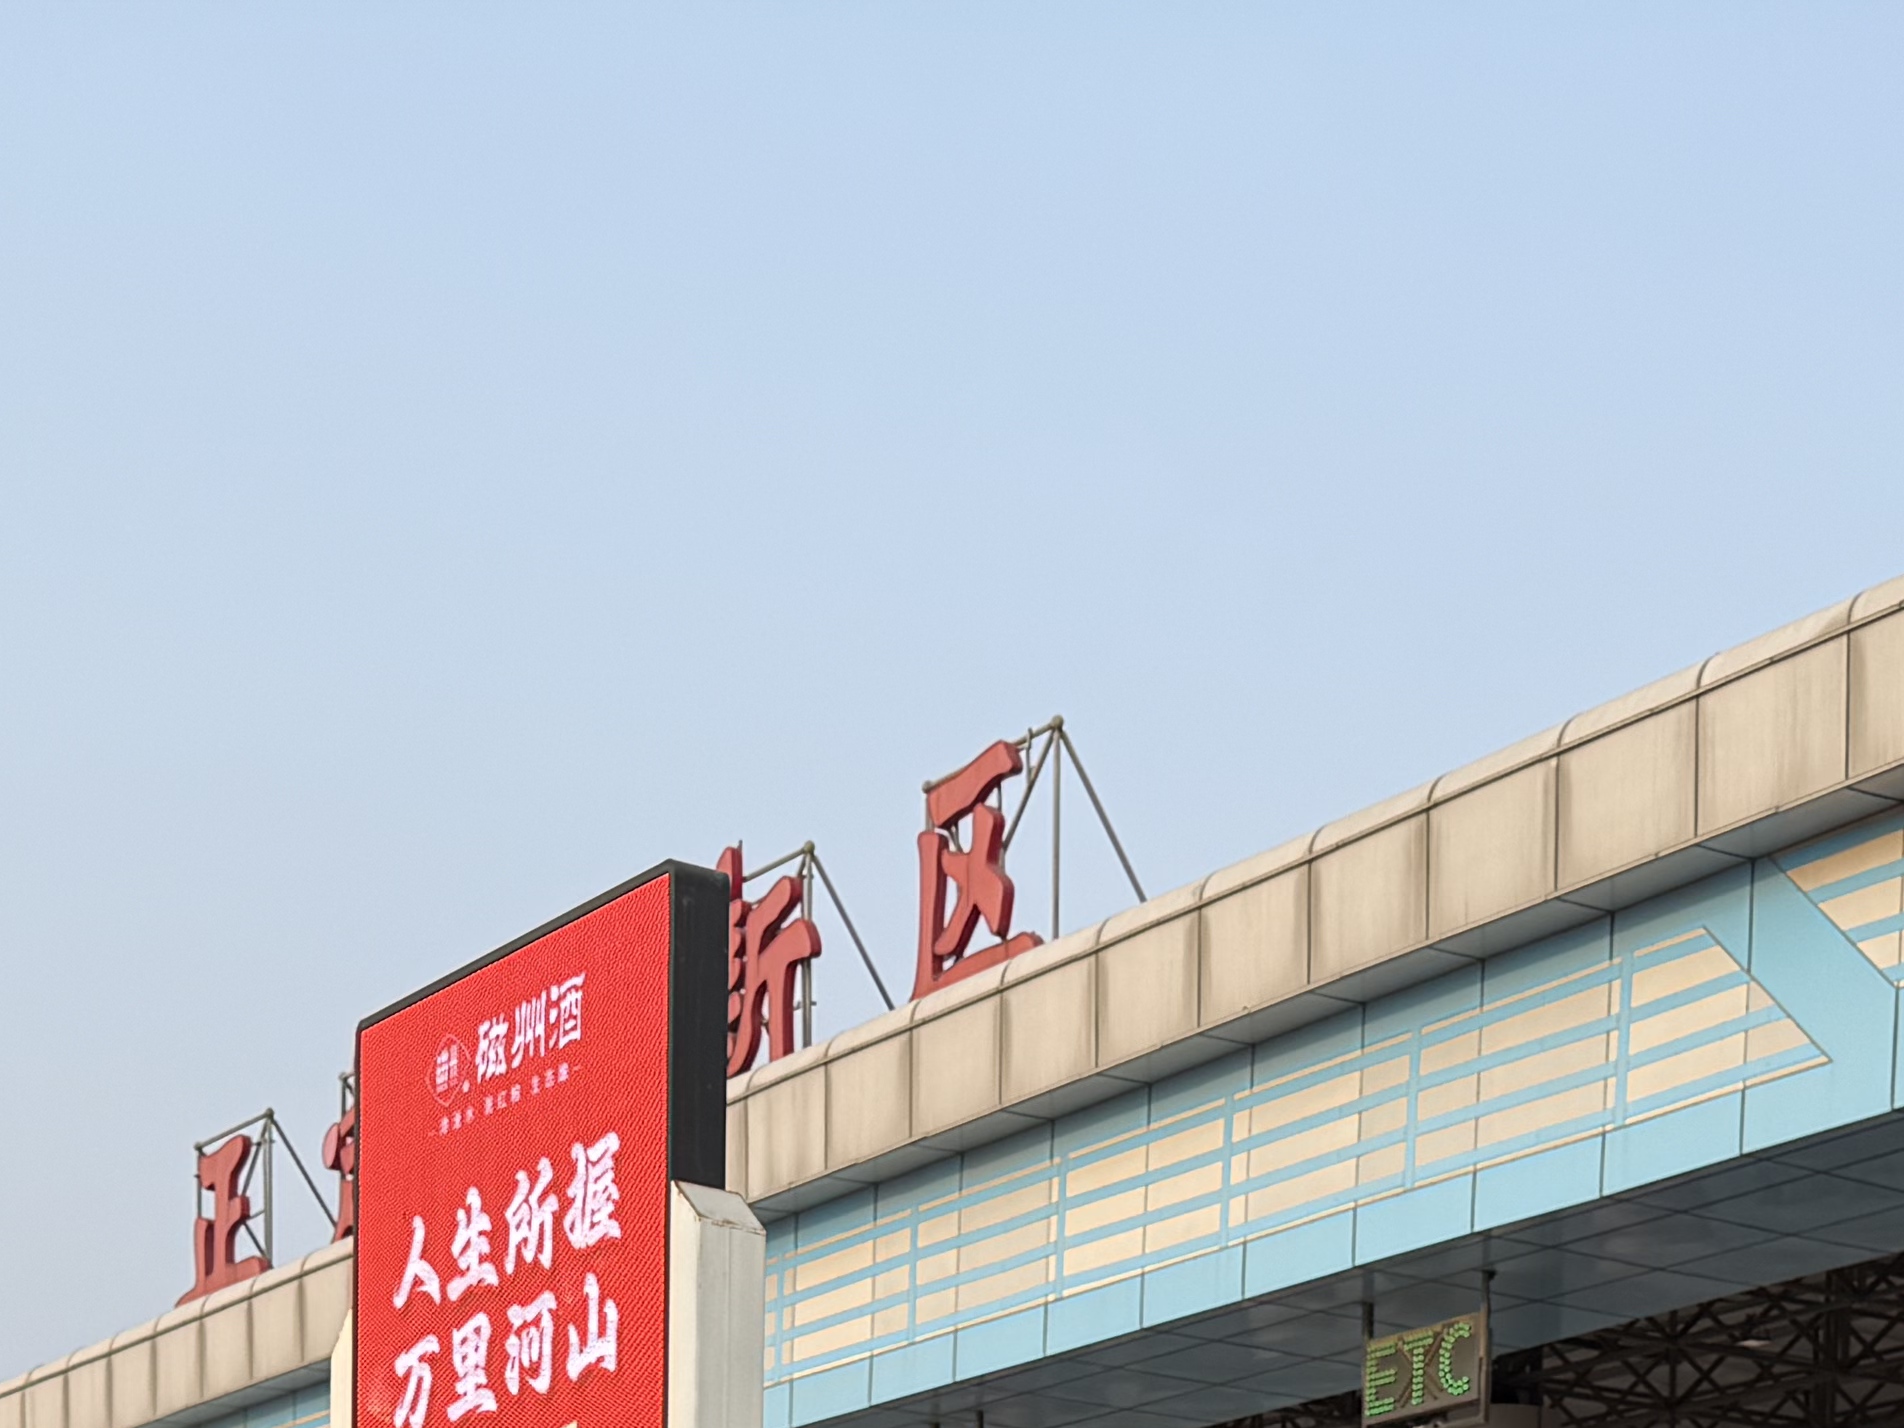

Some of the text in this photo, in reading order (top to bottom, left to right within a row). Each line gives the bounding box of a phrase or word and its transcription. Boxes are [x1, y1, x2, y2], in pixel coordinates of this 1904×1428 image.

[475, 971, 586, 1084] 磁州酒
[393, 1131, 621, 1309] 人生所握
[1365, 1322, 1471, 1416] ETC
